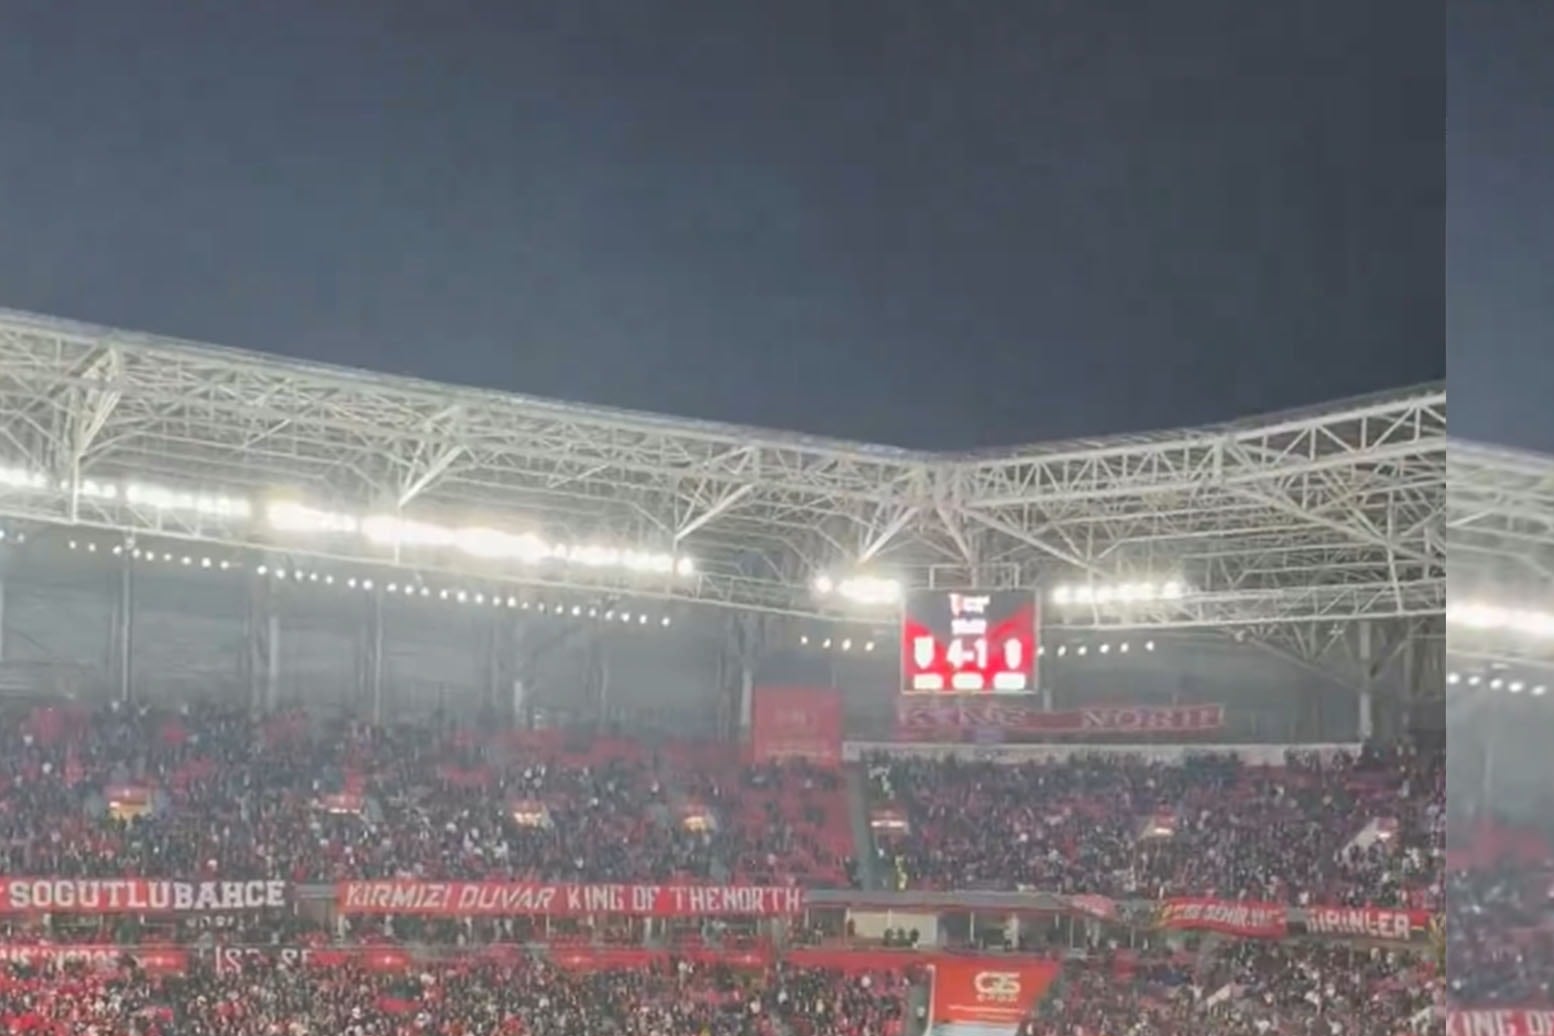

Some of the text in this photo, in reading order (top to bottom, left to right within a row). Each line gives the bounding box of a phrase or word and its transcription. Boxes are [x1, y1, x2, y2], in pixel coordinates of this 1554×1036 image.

[459, 885, 556, 909] DUVAR
[566, 886, 624, 911] KING
[632, 886, 661, 911] OF
